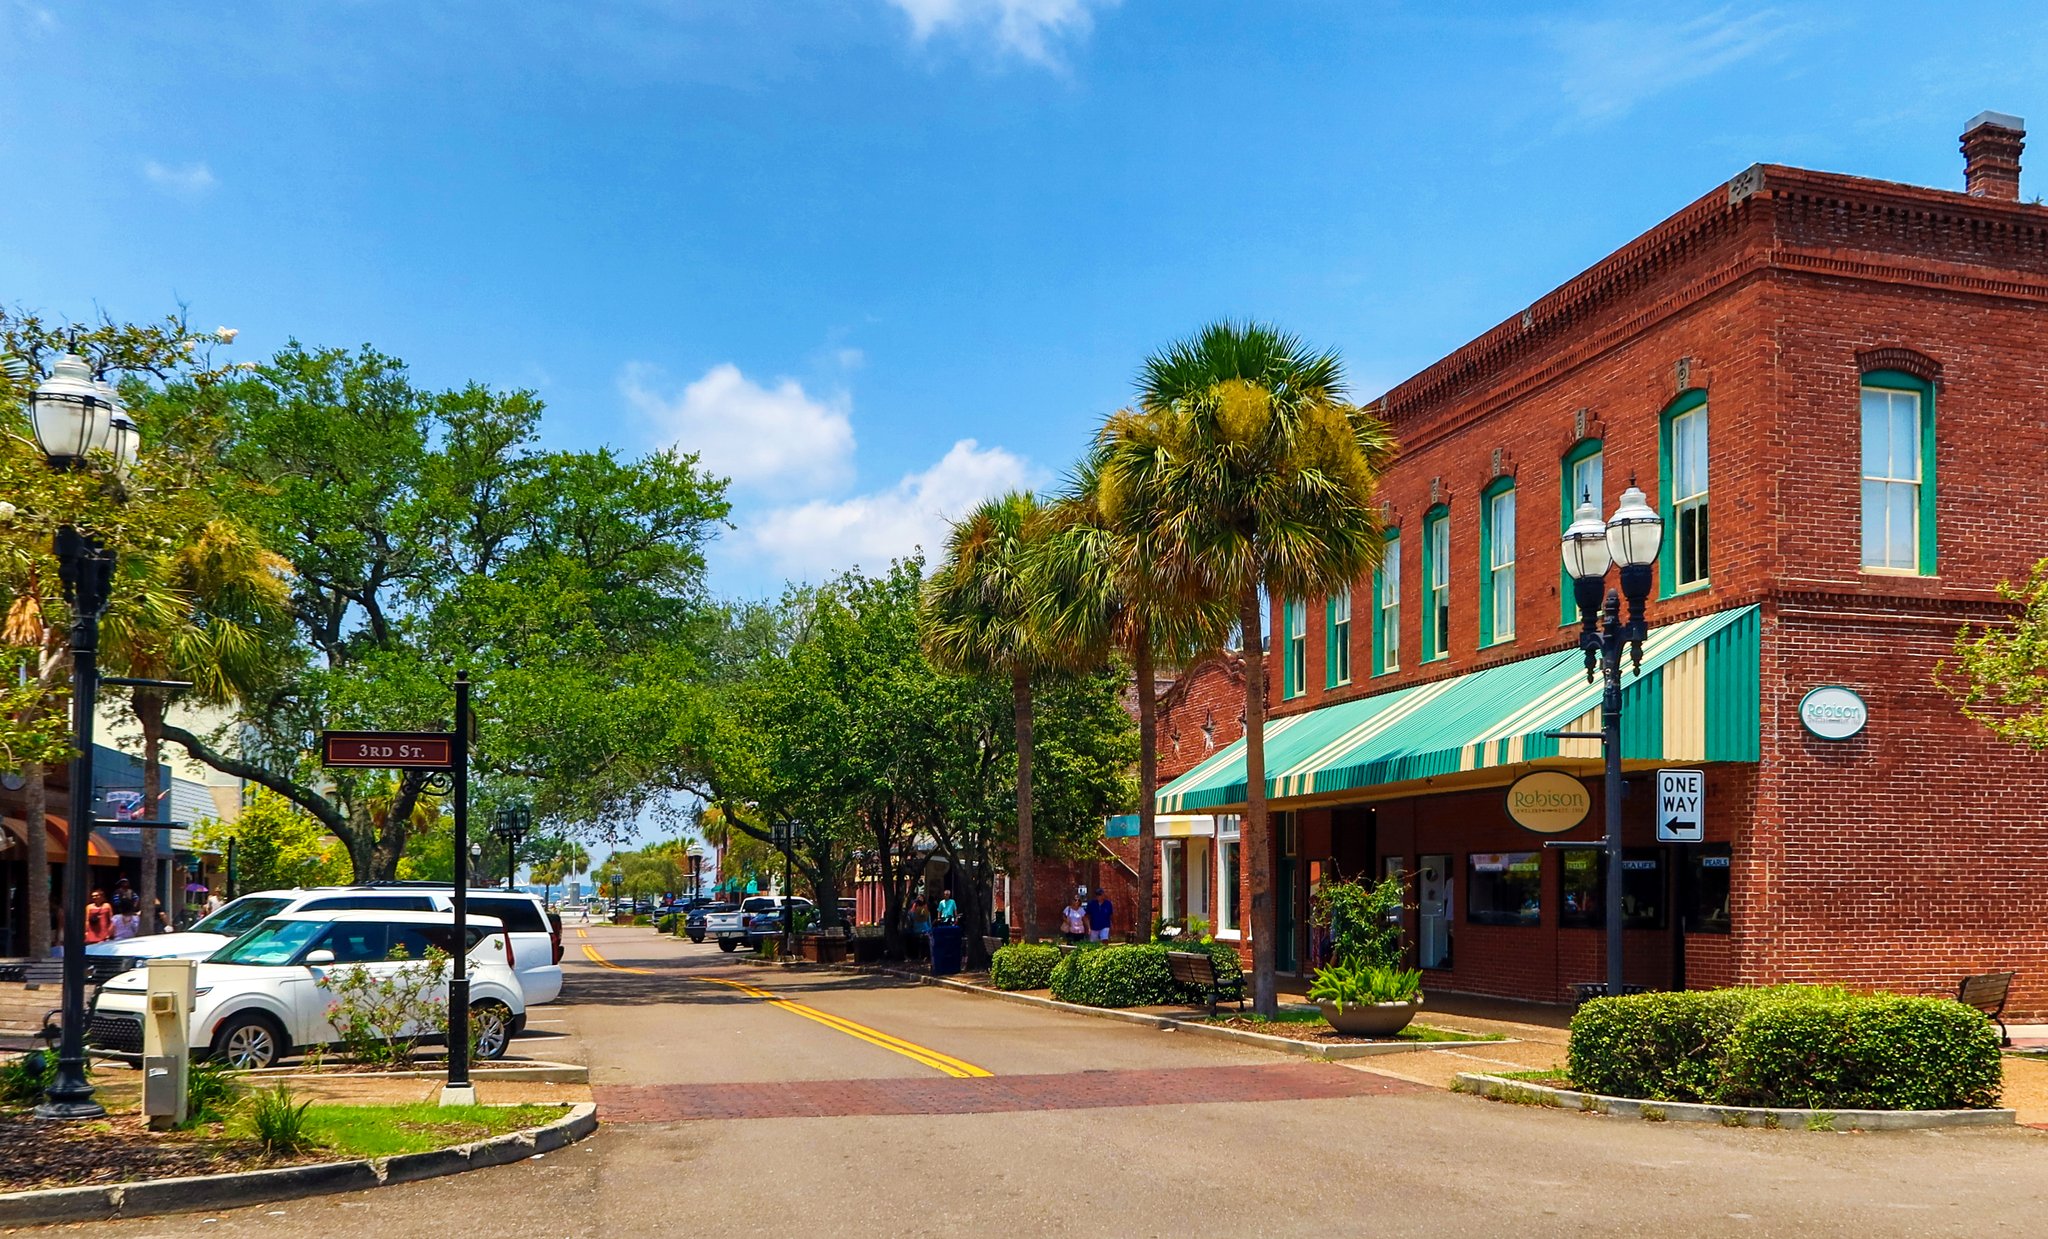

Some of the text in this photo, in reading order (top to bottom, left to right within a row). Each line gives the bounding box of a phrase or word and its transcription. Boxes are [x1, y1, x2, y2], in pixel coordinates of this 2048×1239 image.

[1806, 703, 1861, 719] Robison
[358, 744, 425, 758] 3RD ST.
[1664, 776, 1698, 793] ONE
[1514, 789, 1584, 808] Robison
[1663, 796, 1698, 812] WAY
[1704, 858, 1728, 867] PEARLS
